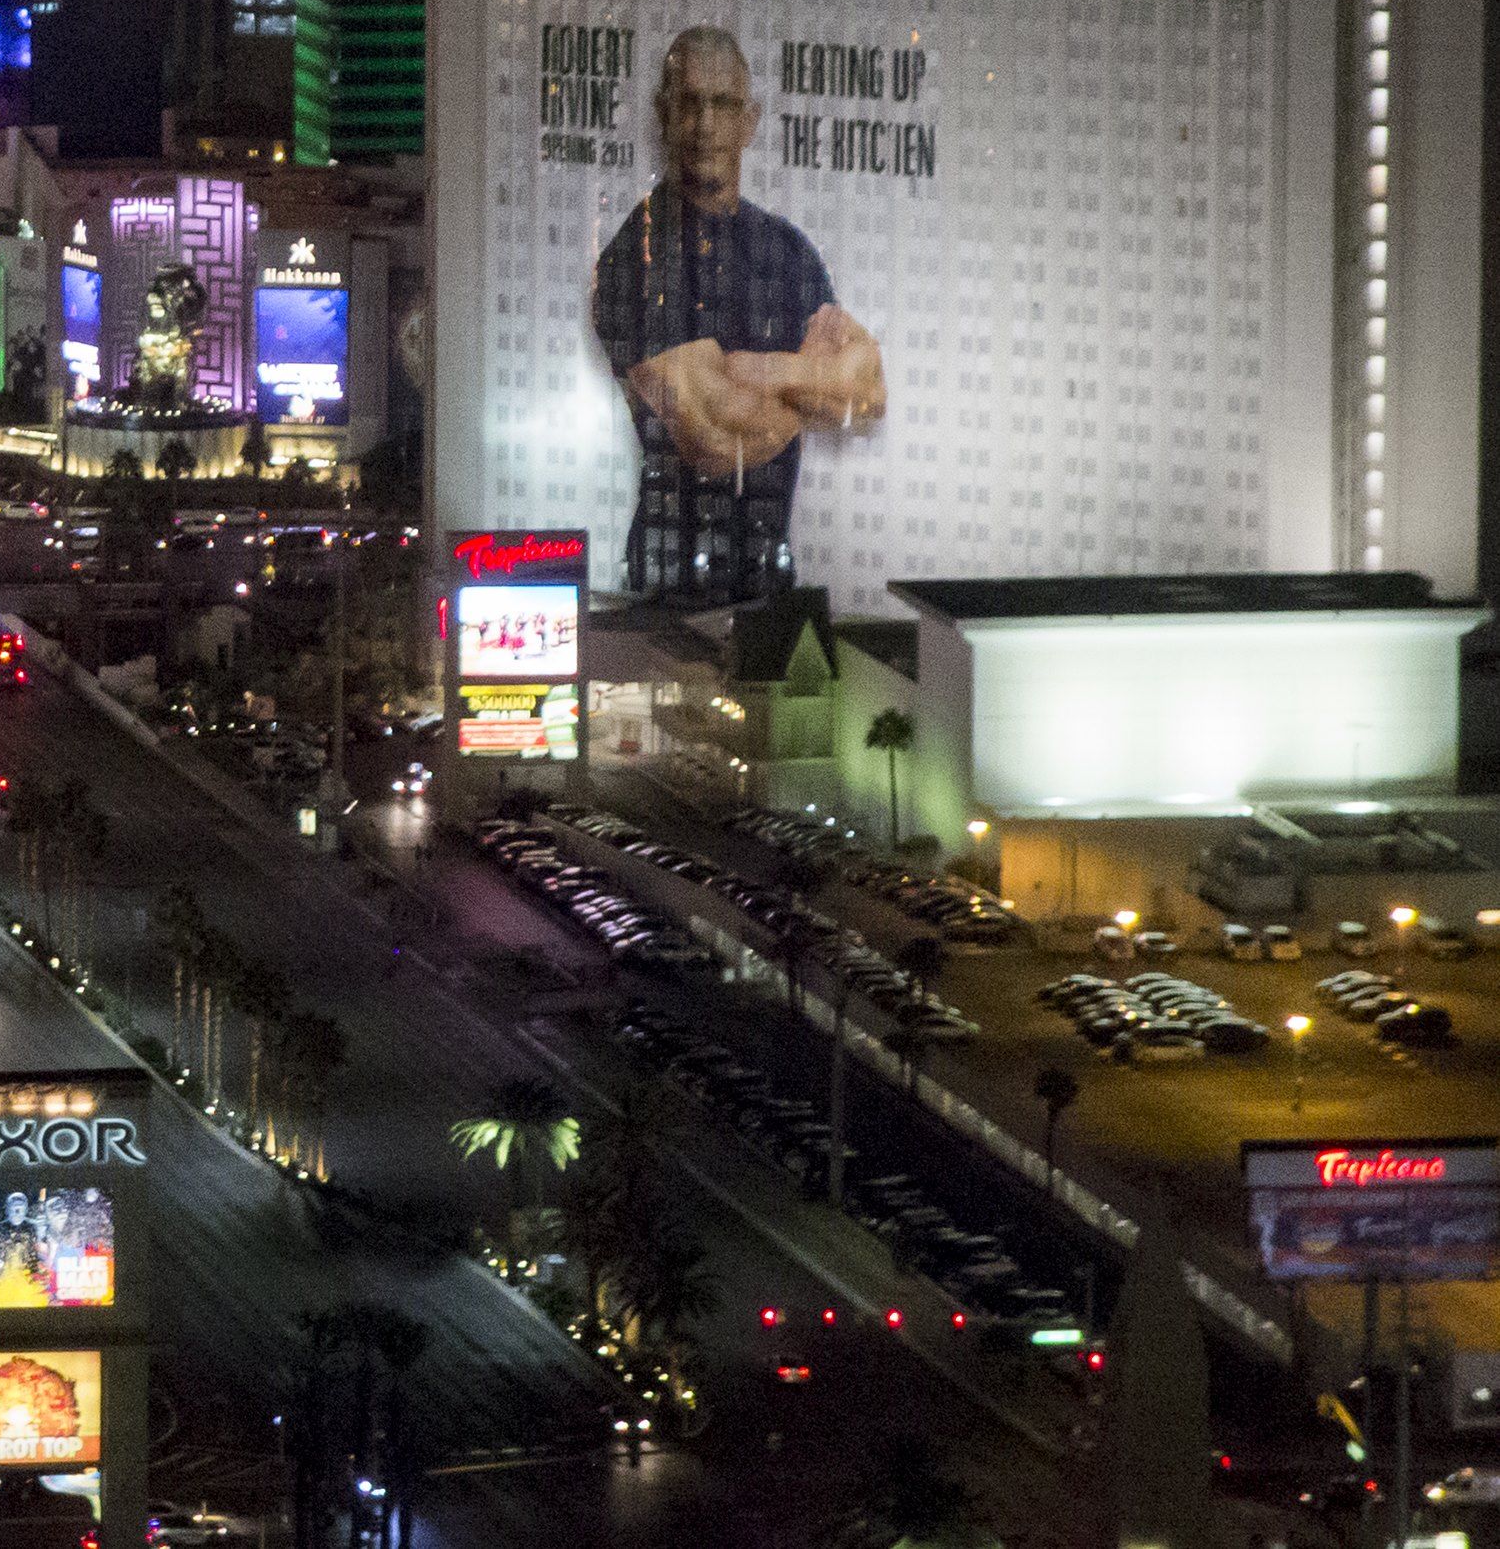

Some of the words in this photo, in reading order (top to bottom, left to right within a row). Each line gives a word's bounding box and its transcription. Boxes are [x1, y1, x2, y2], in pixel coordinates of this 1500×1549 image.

[541, 24, 635, 78] ROBERT
[780, 40, 885, 101] HEATING
[892, 50, 926, 102] UP
[540, 77, 620, 131] IRVINE
[780, 112, 823, 170] THE
[831, 119, 937, 178] KITCHEN
[454, 534, 583, 579] Tropicana
[1315, 1150, 1447, 1188] Tropicana
[43, 1436, 84, 1459] TOP
